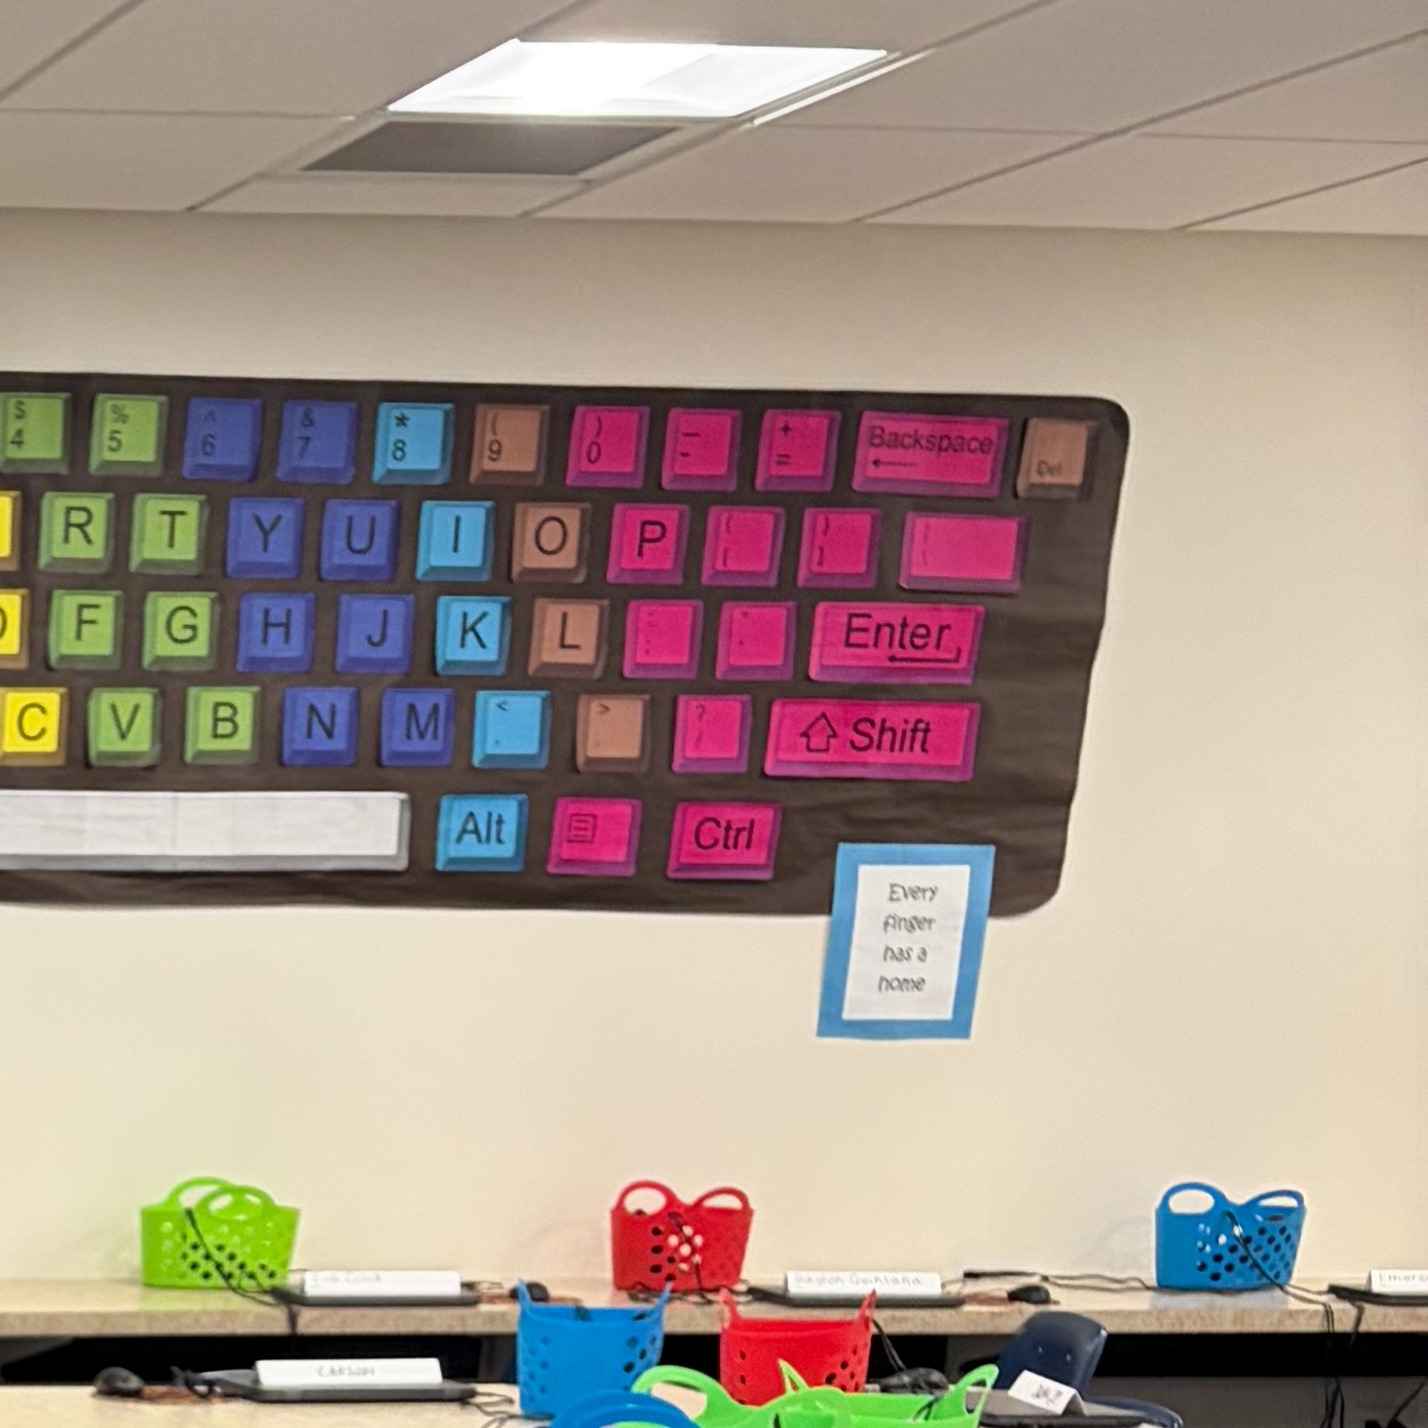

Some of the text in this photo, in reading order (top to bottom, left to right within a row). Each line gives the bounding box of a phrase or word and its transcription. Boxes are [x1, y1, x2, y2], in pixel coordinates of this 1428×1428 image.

[10, 429, 25, 449] 4
[107, 430, 123, 452] 5
[201, 433, 216, 456] 6
[298, 436, 312, 459] 7
[392, 440, 407, 461] 8
[488, 439, 502, 462] 9
[586, 440, 602, 464] 0
[869, 425, 994, 456] Backspace
[63, 506, 93, 545] R
[159, 510, 187, 548] T
[253, 514, 282, 552] Y
[345, 516, 376, 555] U
[453, 516, 460, 553] I
[535, 516, 568, 555] O
[637, 520, 666, 557] P
[76, 604, 100, 641] F
[166, 606, 197, 644] G
[261, 608, 291, 645] H
[366, 610, 388, 647] J
[460, 612, 488, 649] K
[559, 612, 580, 649] L
[844, 613, 951, 651] Enter
[17, 703, 47, 741] C
[110, 703, 140, 740] V
[211, 702, 238, 739] B
[306, 704, 336, 740] N
[405, 703, 440, 740] M
[850, 717, 931, 753] Shift
[456, 811, 504, 844] Alt
[694, 817, 754, 850] Ctrl
[888, 882, 939, 902] Every
[883, 913, 937, 934] finger
[883, 945, 928, 962] has a
[878, 975, 926, 992] home
